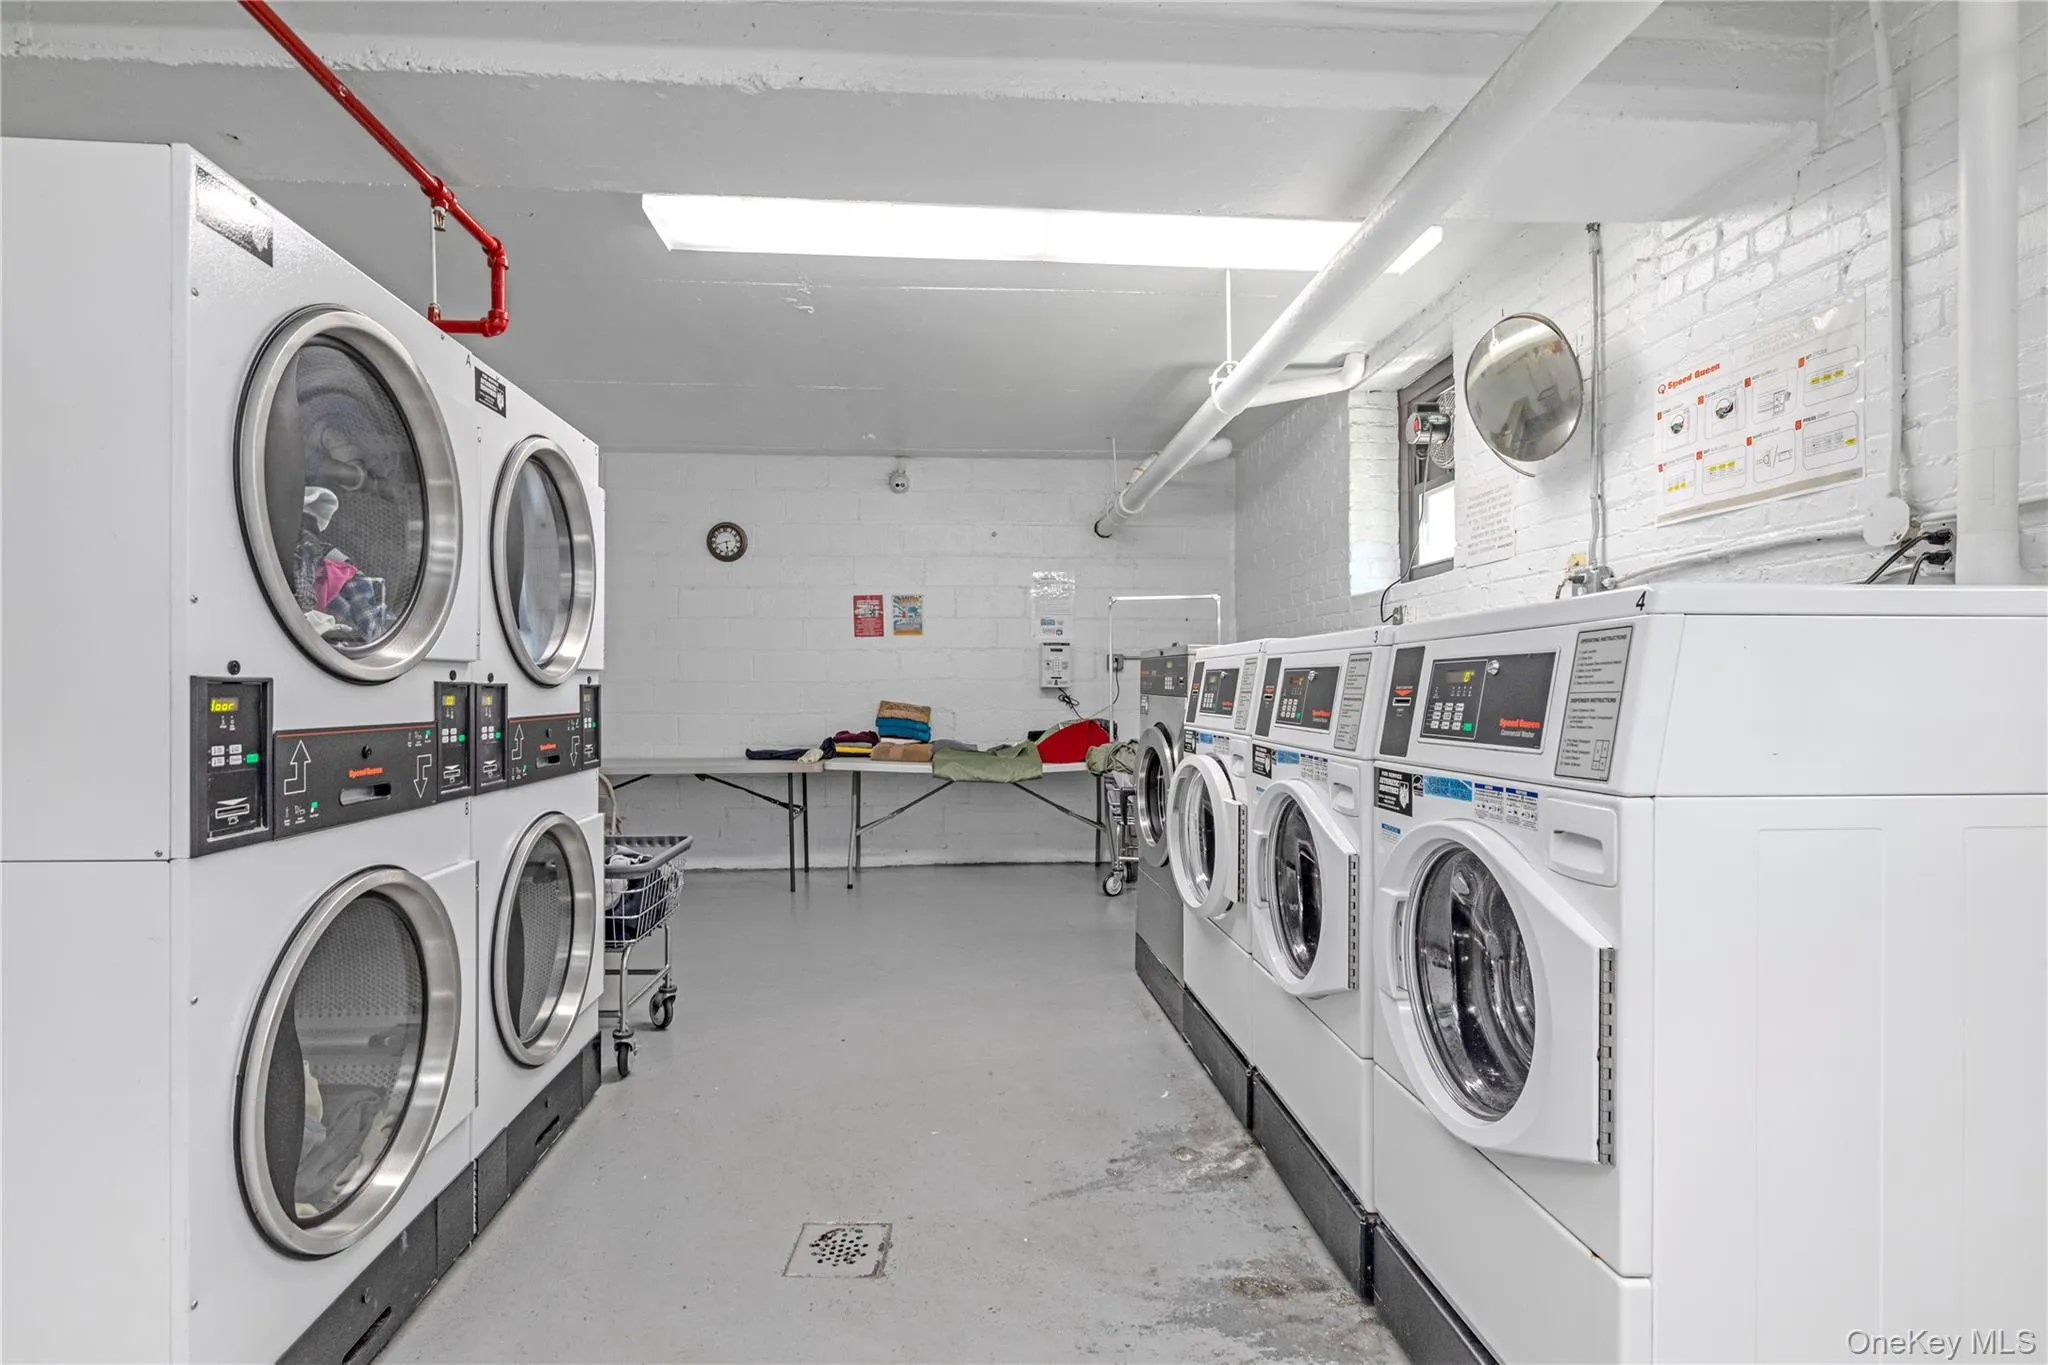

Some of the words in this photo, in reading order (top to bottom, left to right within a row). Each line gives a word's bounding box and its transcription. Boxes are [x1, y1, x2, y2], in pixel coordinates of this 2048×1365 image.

[465, 353, 472, 369] A
[1667, 373, 1693, 390] Speed
[1694, 362, 1721, 379] Queen
[1635, 591, 1647, 612] 4
[1373, 630, 1380, 643] 3
[1499, 718, 1519, 729] Speed
[1519, 719, 1541, 729] Queen
